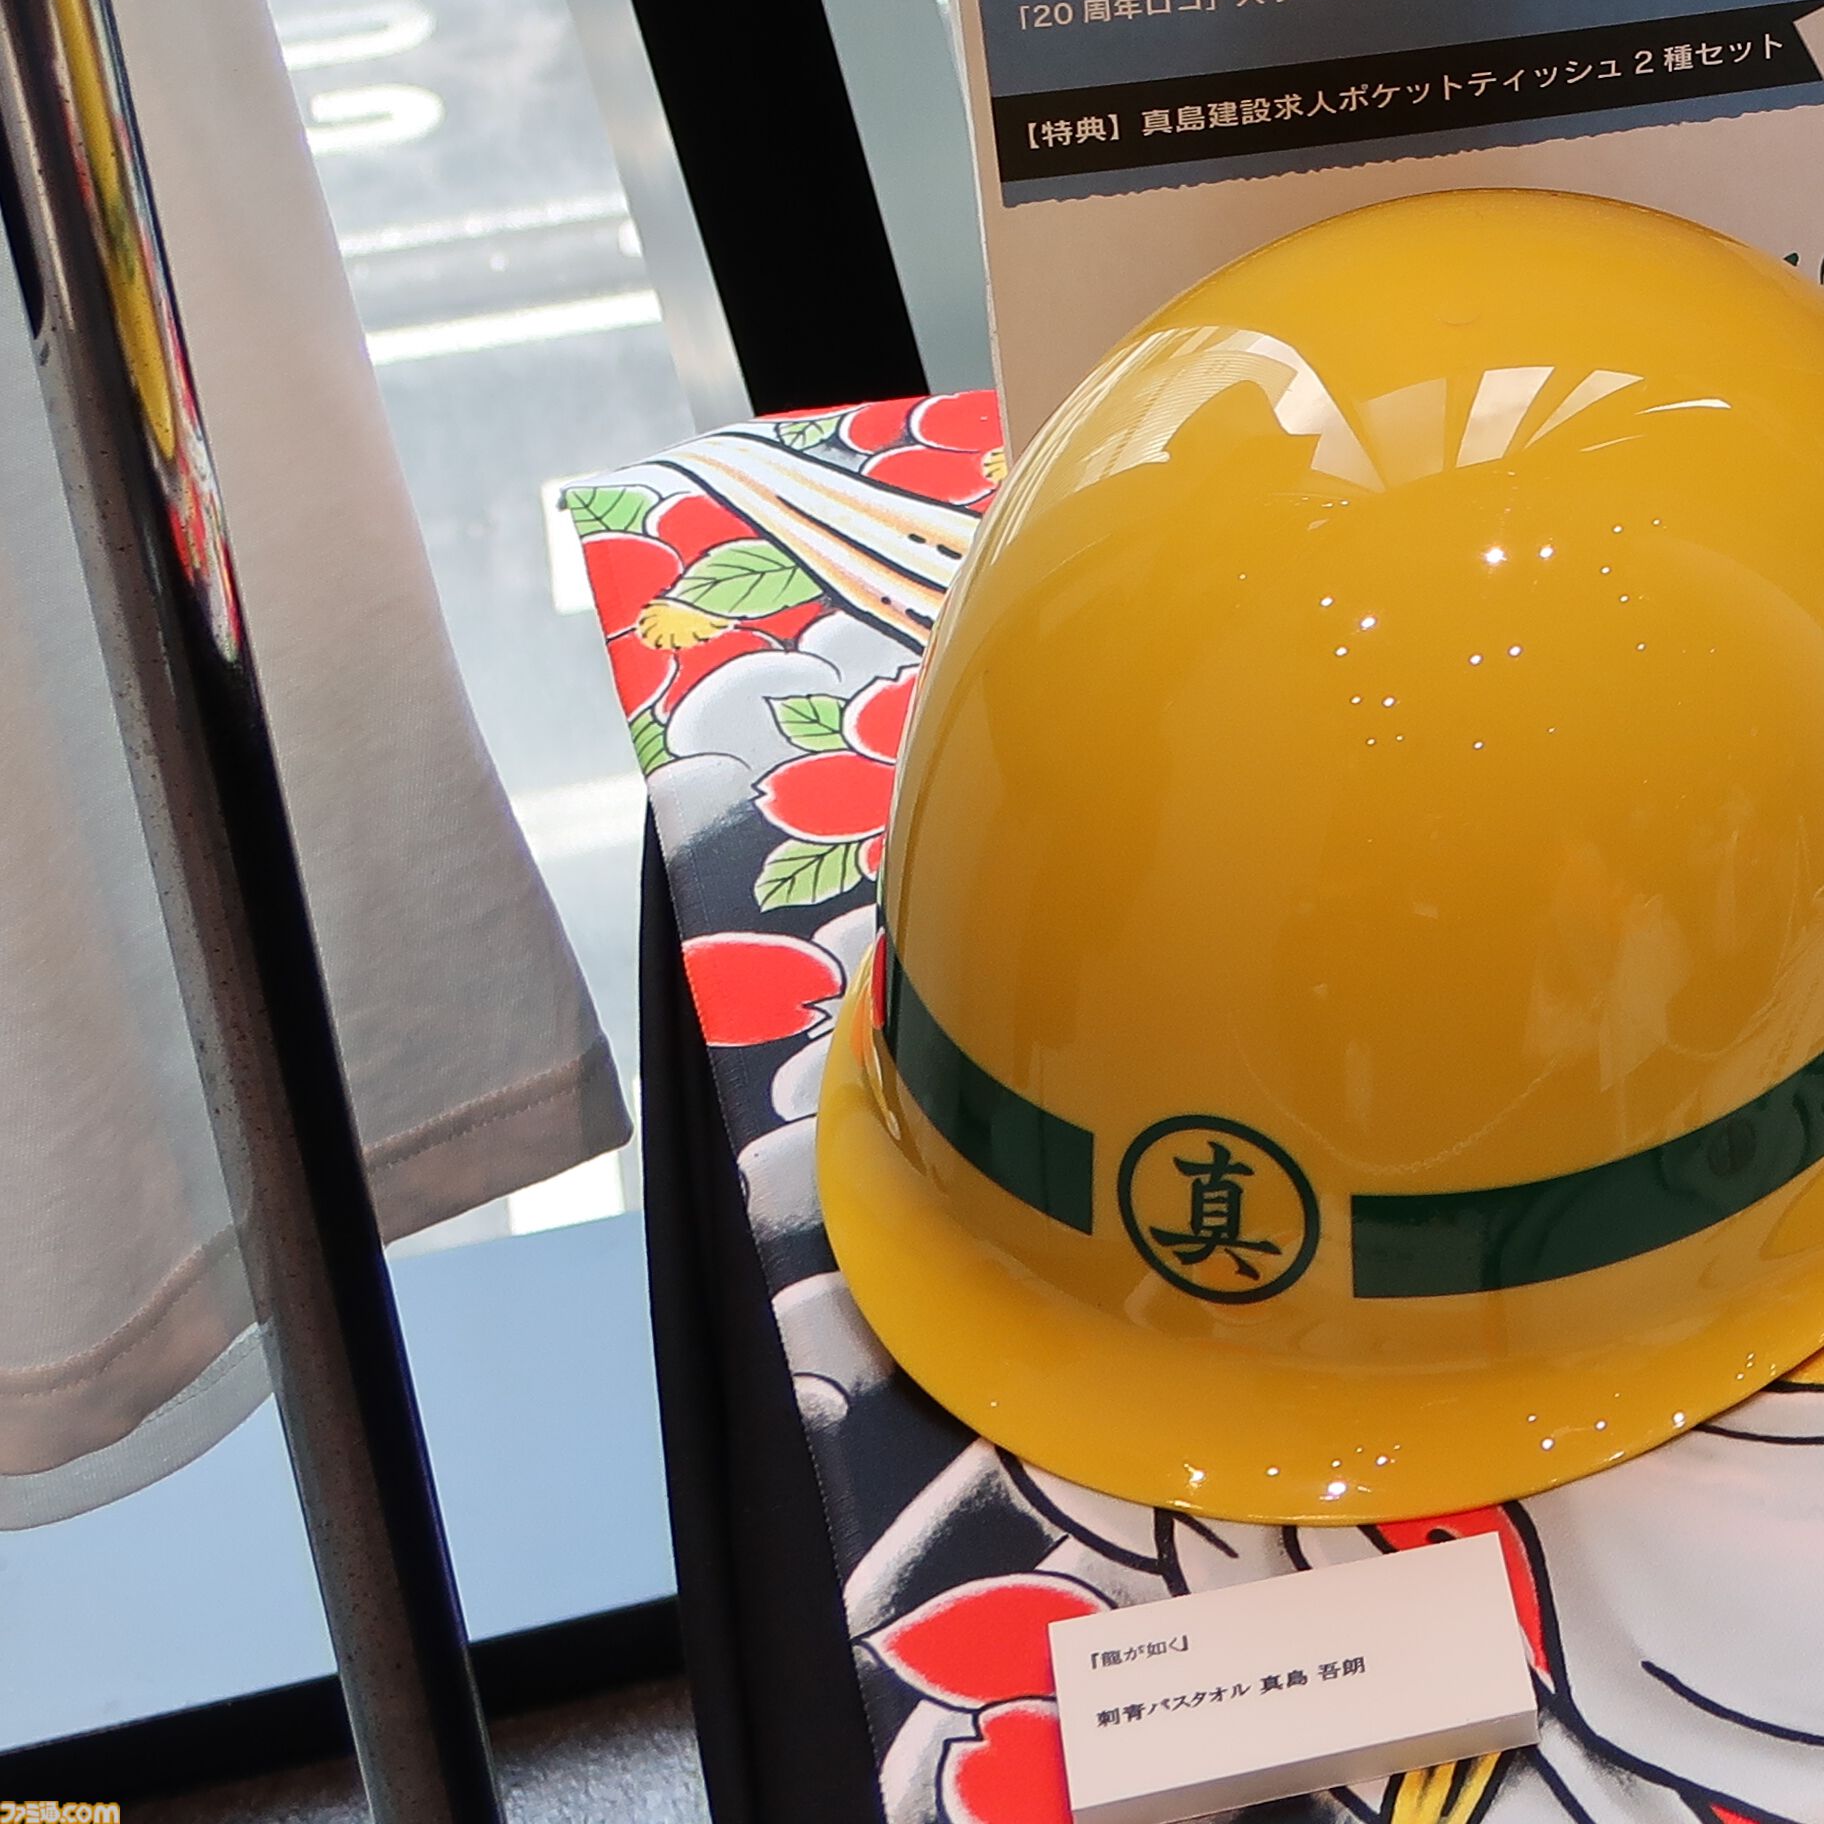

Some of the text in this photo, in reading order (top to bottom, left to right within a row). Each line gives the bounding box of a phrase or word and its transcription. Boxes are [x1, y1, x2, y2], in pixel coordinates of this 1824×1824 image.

[1149, 1140, 1283, 1282] 真
[1090, 1634, 1190, 1670] 『龍が如く』
[1096, 1656, 1367, 1729] 刺青バスタオル 真島 吾朗
